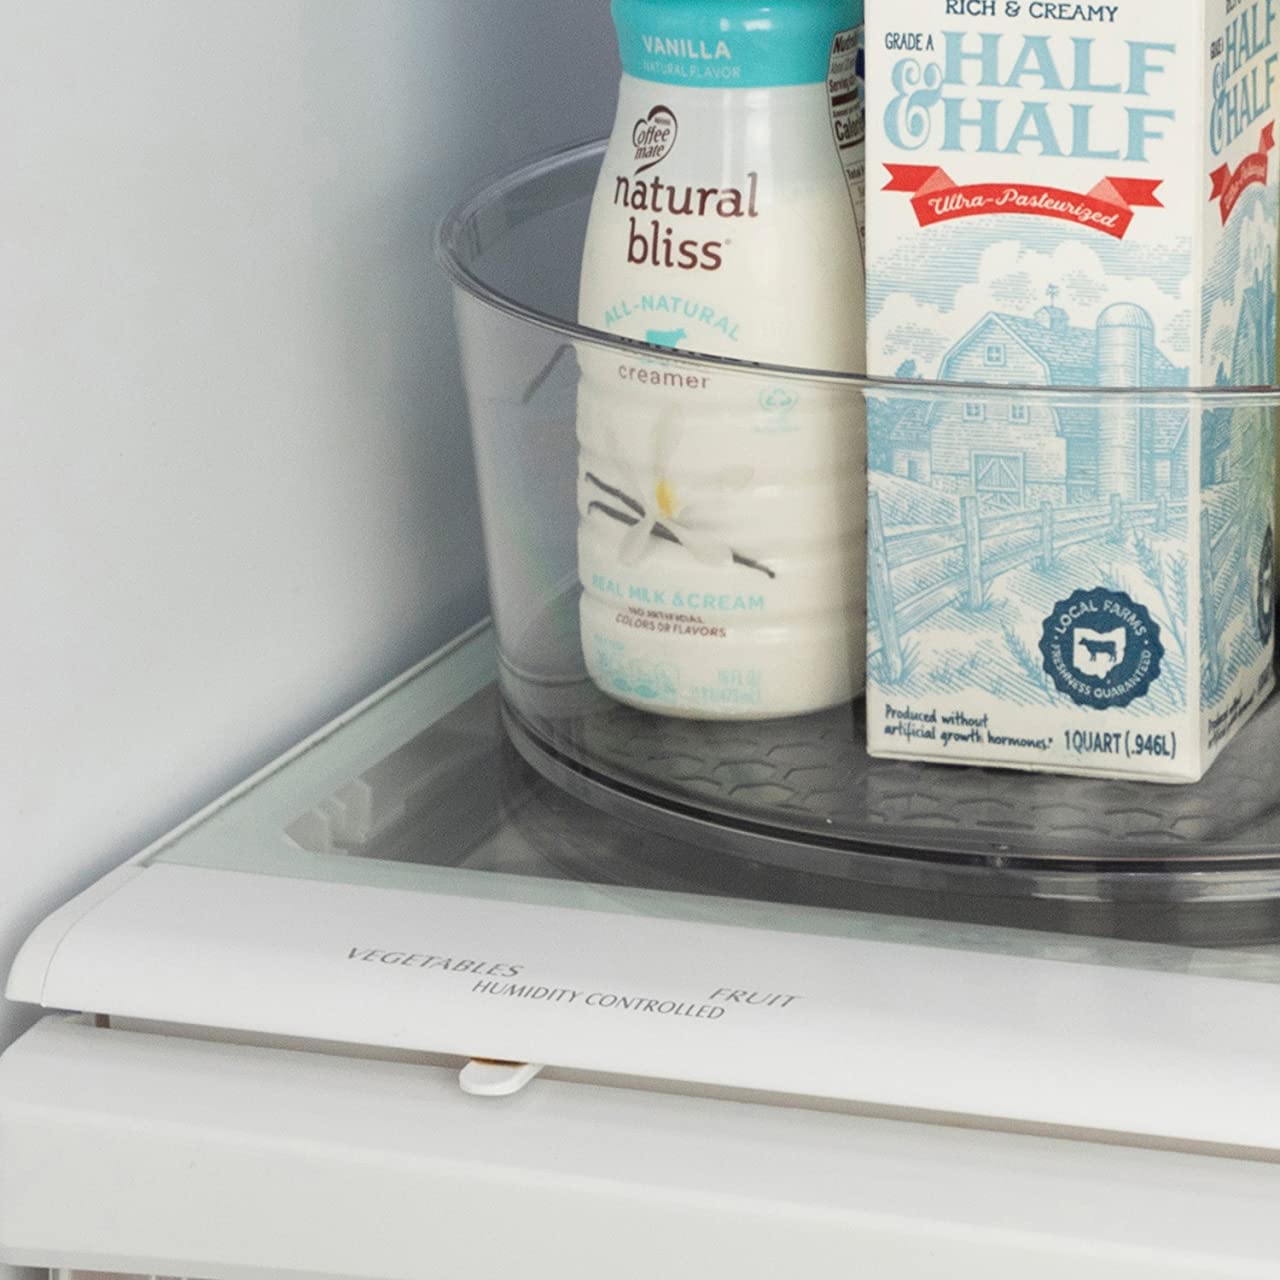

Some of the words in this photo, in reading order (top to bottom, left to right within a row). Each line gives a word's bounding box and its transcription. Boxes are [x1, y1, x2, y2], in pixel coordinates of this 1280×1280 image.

[945, 0, 996, 17] RICH
[1004, 0, 1021, 18] &
[1028, 1, 1119, 23] CREAMY
[642, 34, 732, 60] VANILLA
[884, 31, 923, 52] GRADE
[925, 34, 934, 52] A
[940, 31, 1176, 96] HALF
[883, 56, 945, 151] &
[940, 96, 1176, 162] HALF
[1223, 53, 1278, 142] HALF
[634, 144, 665, 160] mate
[613, 172, 759, 217] natural
[927, 188, 1120, 230] Ultra-Pasteurized
[627, 218, 723, 271] bliss
[604, 295, 740, 342] ALL-NATURAL
[618, 364, 711, 390] creamer
[628, 584, 665, 605] MILK
[687, 593, 765, 611] CREAM
[615, 615, 656, 633] COLORS
[672, 622, 727, 638] FLAVORS
[1054, 599, 1099, 635] LOCAL
[1103, 599, 1147, 637] FARMS
[1050, 644, 1091, 696] FRESHNESS
[1093, 649, 1151, 699] GUARANTEED
[885, 704, 937, 724] Produced
[941, 711, 988, 727] without
[884, 724, 936, 740] artificial
[940, 727, 981, 747] growth
[346, 946, 525, 979] VEGETABLES
[471, 980, 583, 1004] HUMIDITY
[584, 992, 726, 1021] CONTROLLED
[708, 987, 803, 1009] FRUIT
